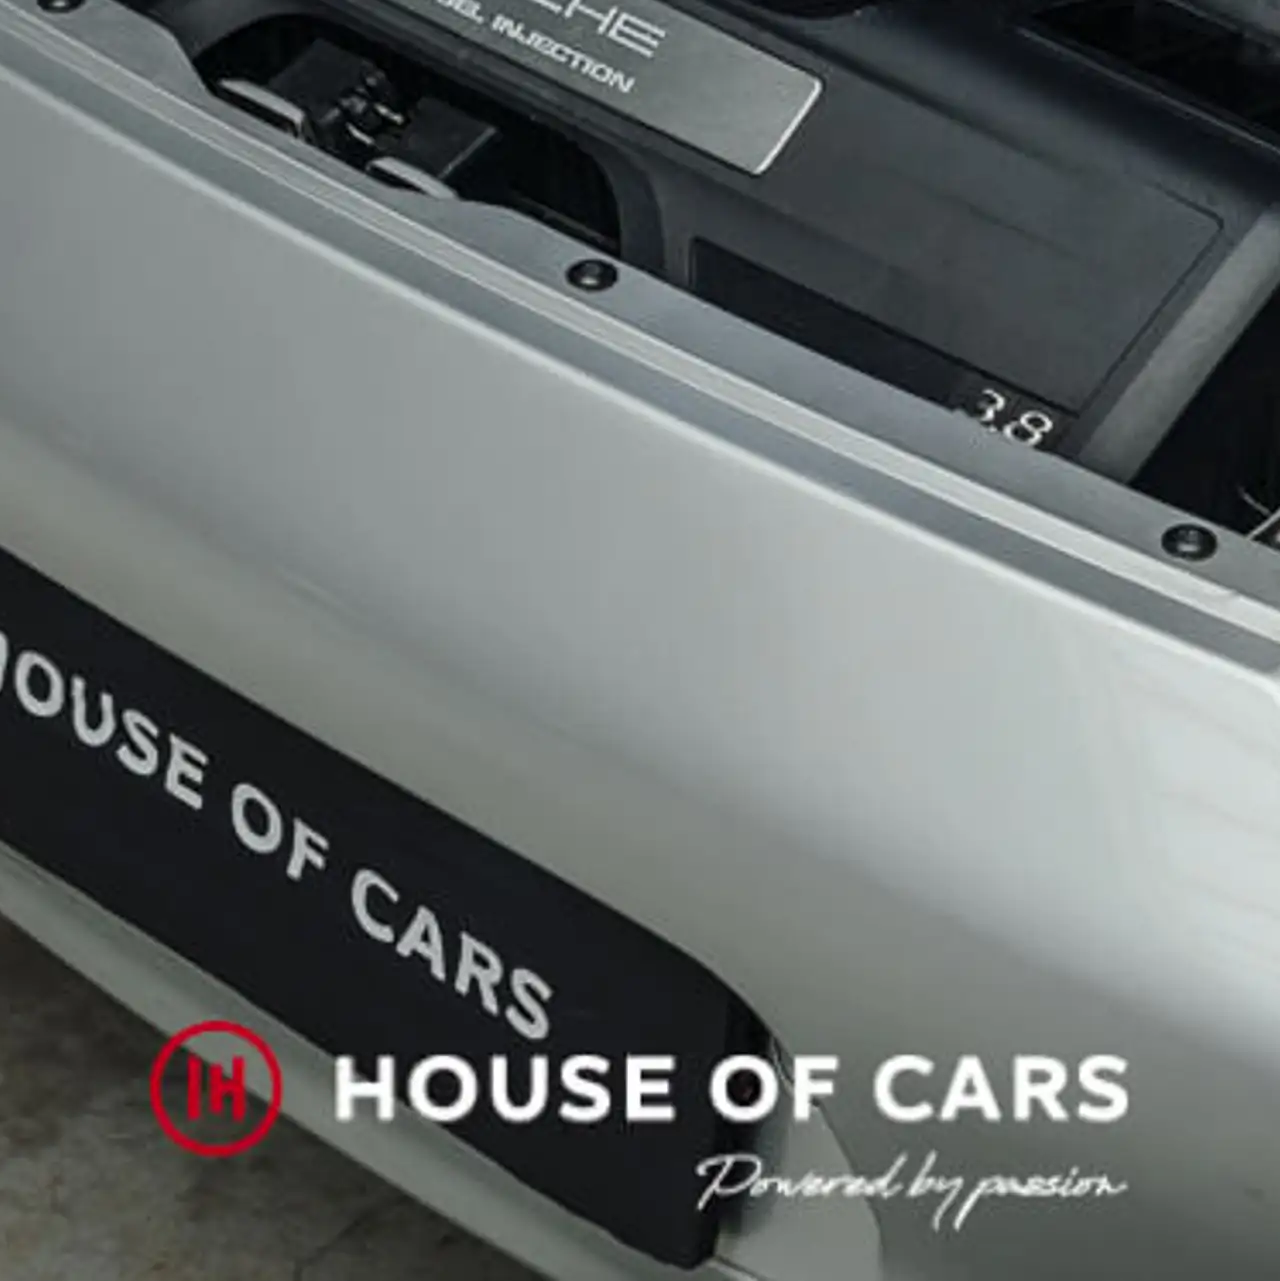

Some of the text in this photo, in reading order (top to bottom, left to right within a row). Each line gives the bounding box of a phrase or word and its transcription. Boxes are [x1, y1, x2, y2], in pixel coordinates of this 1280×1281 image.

[491, 14, 637, 95] INJECTION
[980, 388, 1053, 447] 3.8
[230, 782, 331, 882] OF
[351, 868, 555, 1040] CARS
